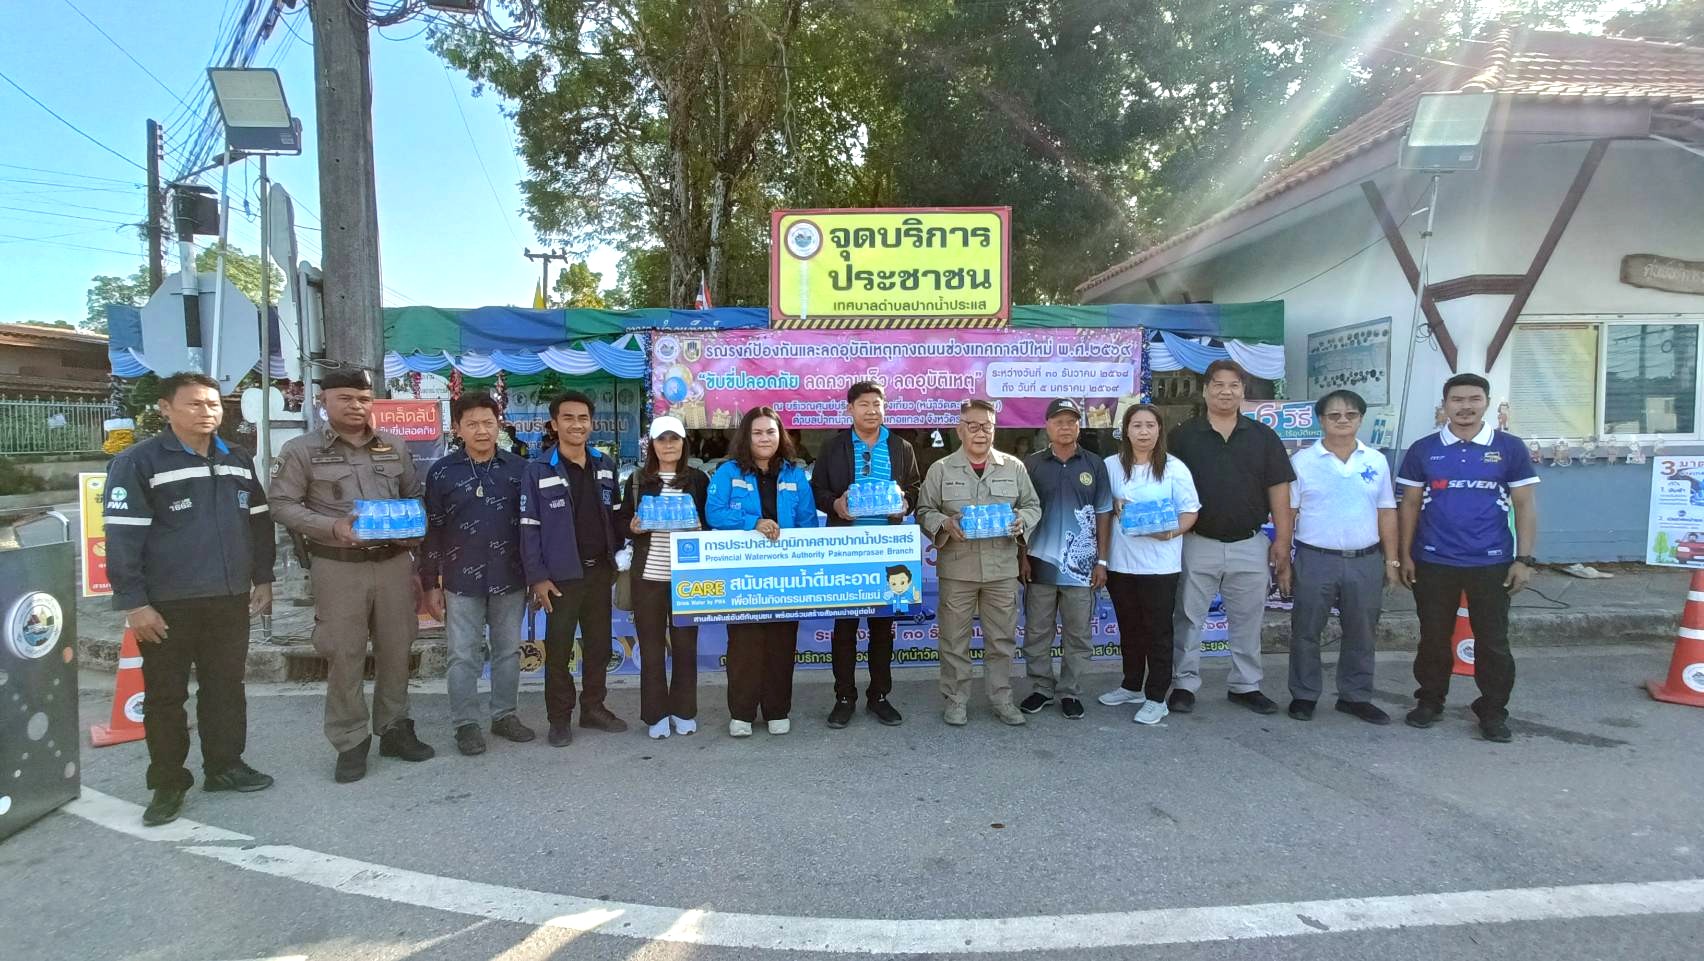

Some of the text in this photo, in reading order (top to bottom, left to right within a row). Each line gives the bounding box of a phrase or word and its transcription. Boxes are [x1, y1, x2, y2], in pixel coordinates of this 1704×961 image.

[829, 217, 991, 261] จุดบริการ
[828, 264, 992, 291] ประชาชน
[833, 296, 987, 311] เทศบาลตำบลปากน้ำประแส
[1257, 404, 1278, 428] 6
[1660, 460, 1676, 476] 3
[705, 554, 742, 562] Provincial
[744, 552, 789, 561] Waterworks
[791, 551, 825, 559] Authority
[887, 547, 914, 555] Branch
[677, 580, 727, 599] CARE
[730, 568, 881, 592] สนับสนุนน้ำดื่มสะอาด
